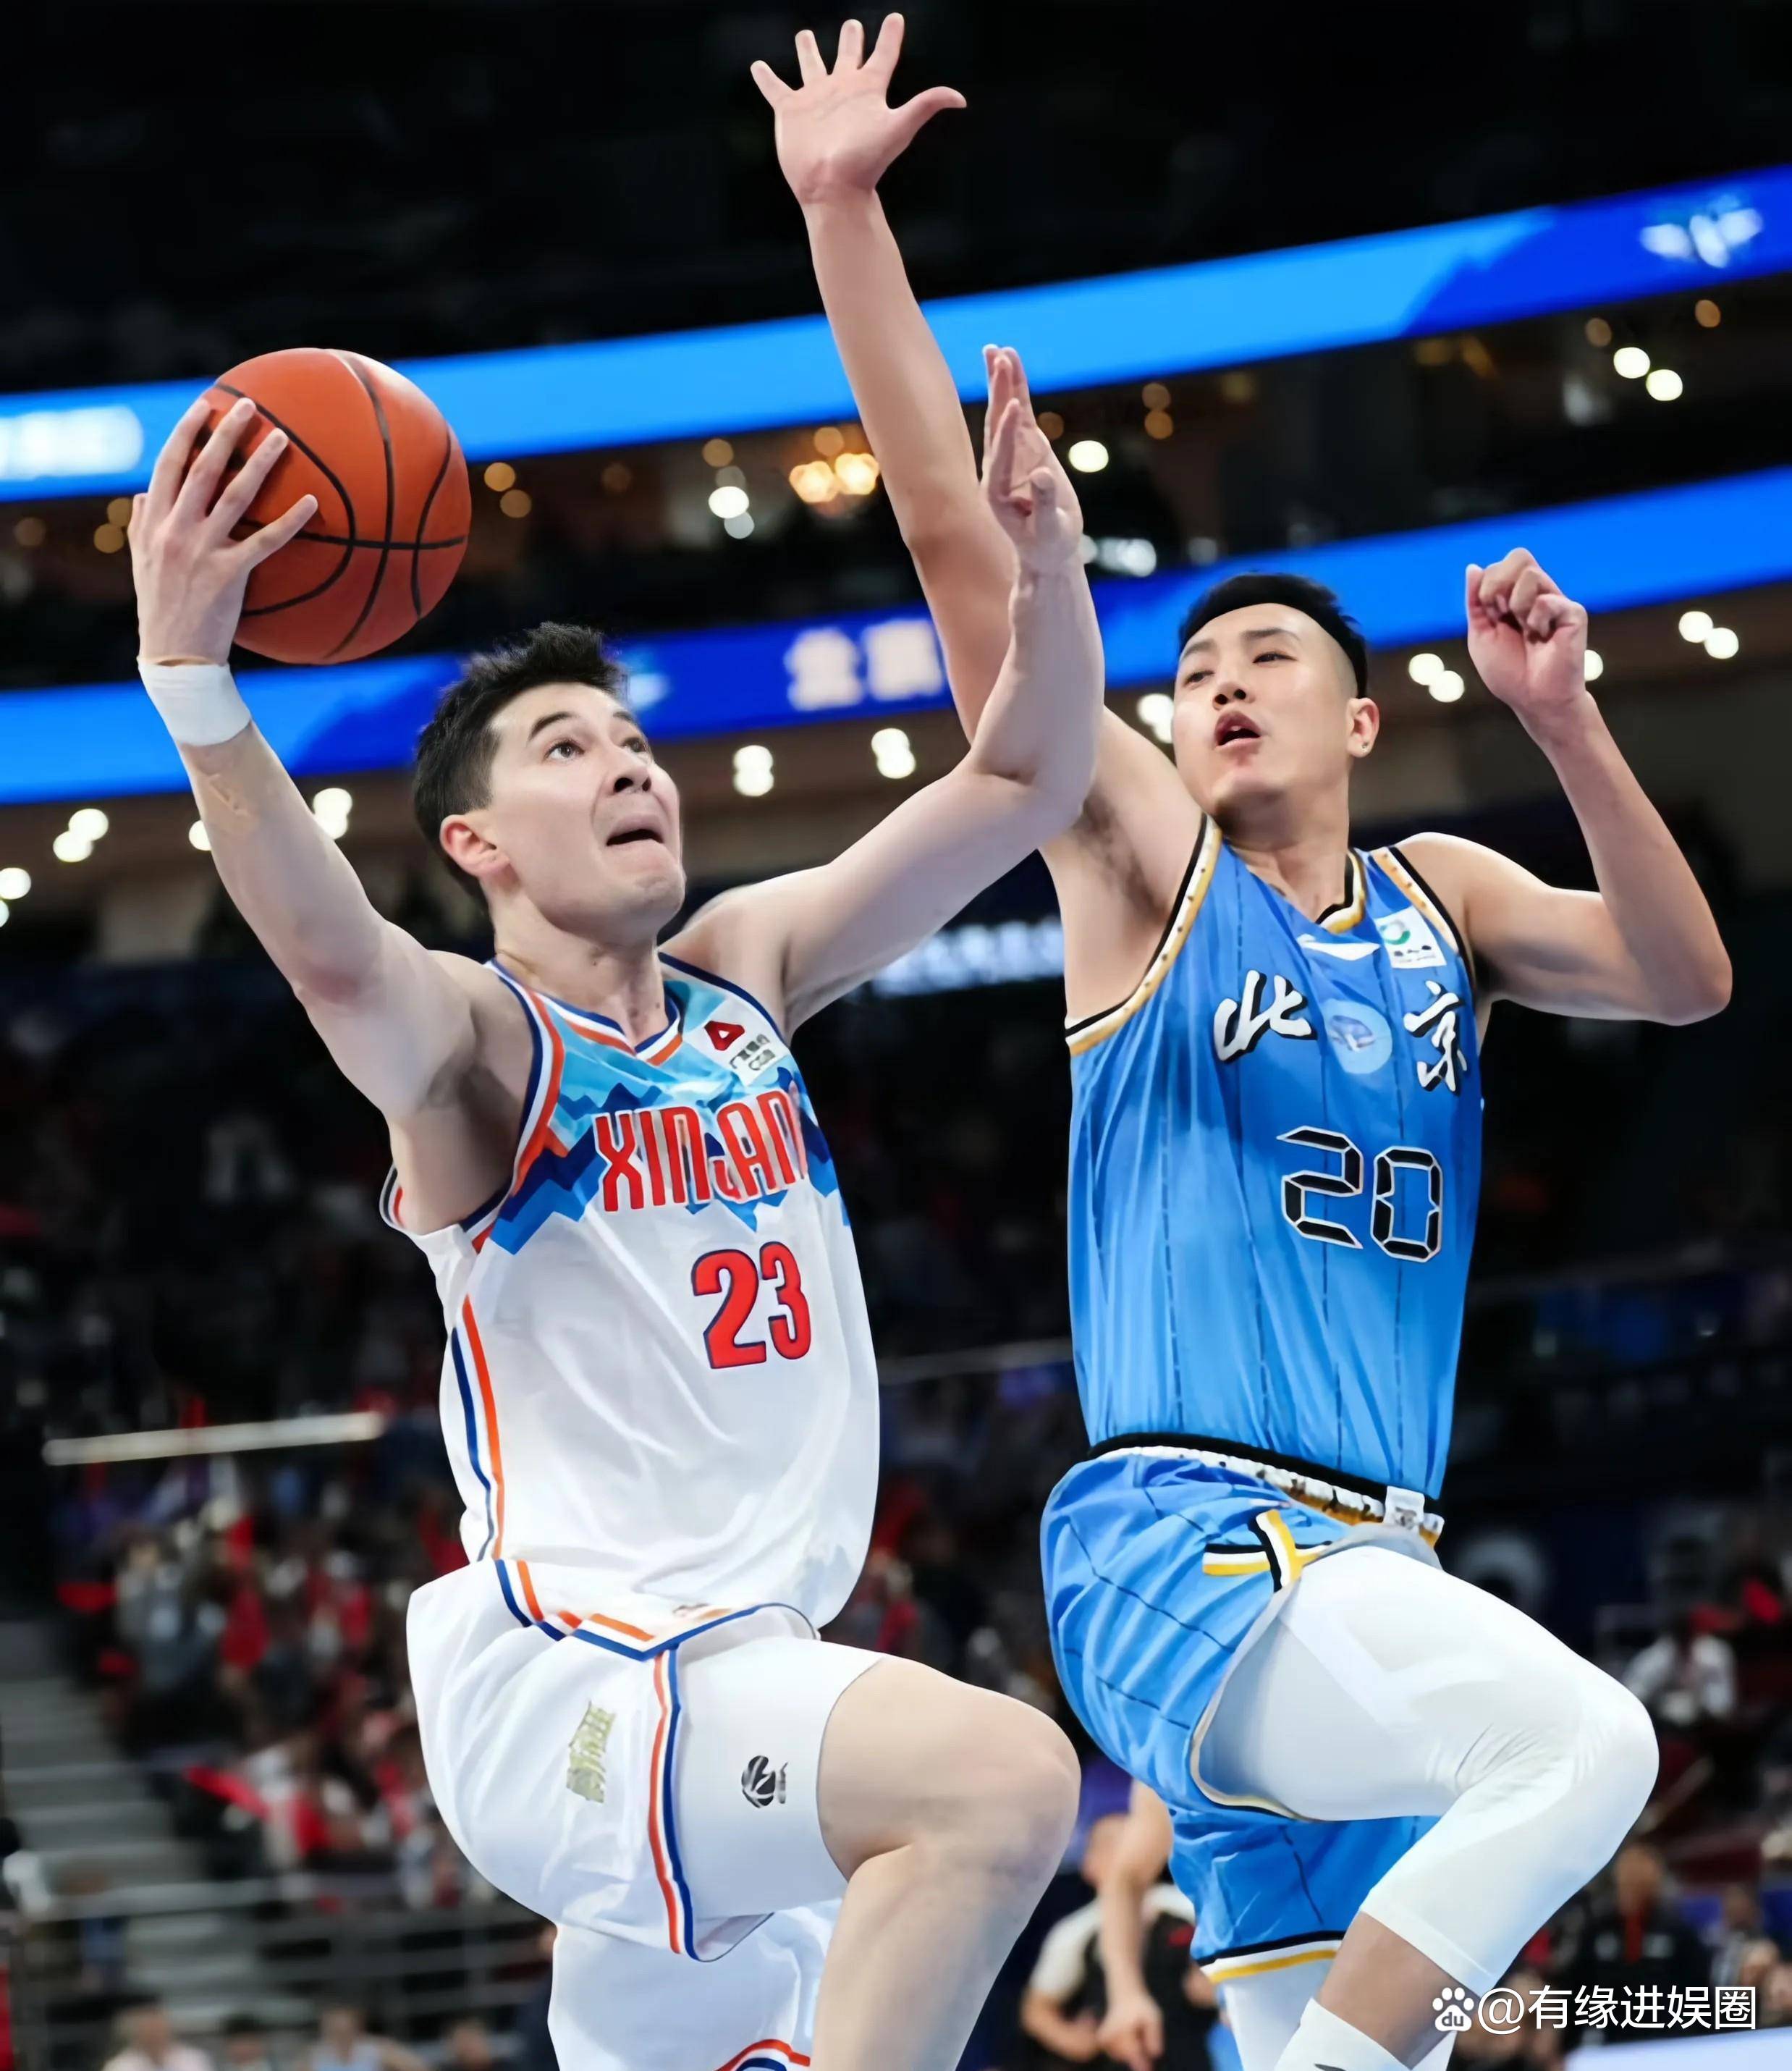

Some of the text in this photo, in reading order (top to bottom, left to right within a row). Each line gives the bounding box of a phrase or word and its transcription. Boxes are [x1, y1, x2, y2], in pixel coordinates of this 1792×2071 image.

[593, 1083, 808, 1212] XINJAN
[1276, 1126, 1443, 1263] 20
[690, 1241, 812, 1370] 23
